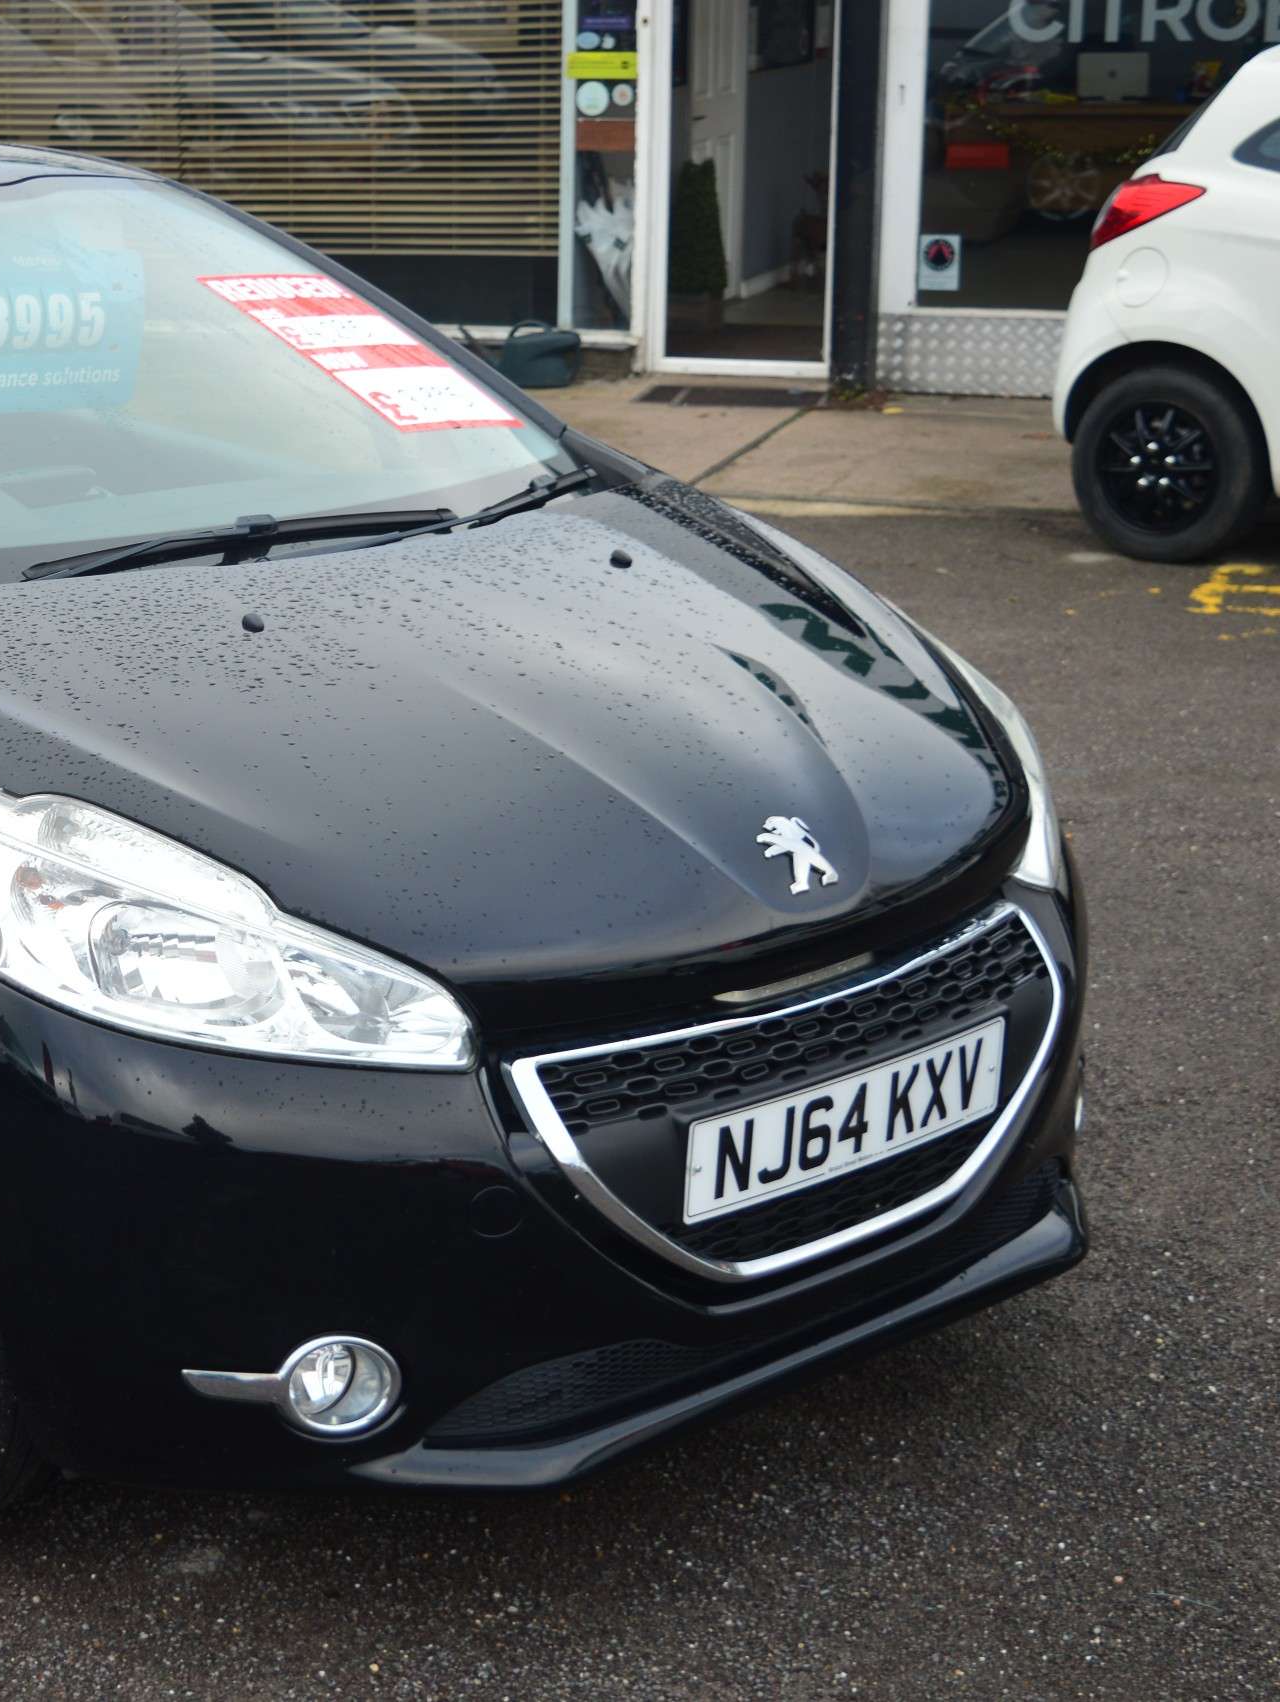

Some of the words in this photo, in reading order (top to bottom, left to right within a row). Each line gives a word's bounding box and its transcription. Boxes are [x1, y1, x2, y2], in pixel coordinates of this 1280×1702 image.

[43, 367, 121, 386] solutions
[714, 1082, 869, 1200] NJ64
[886, 1037, 983, 1142] KXV
